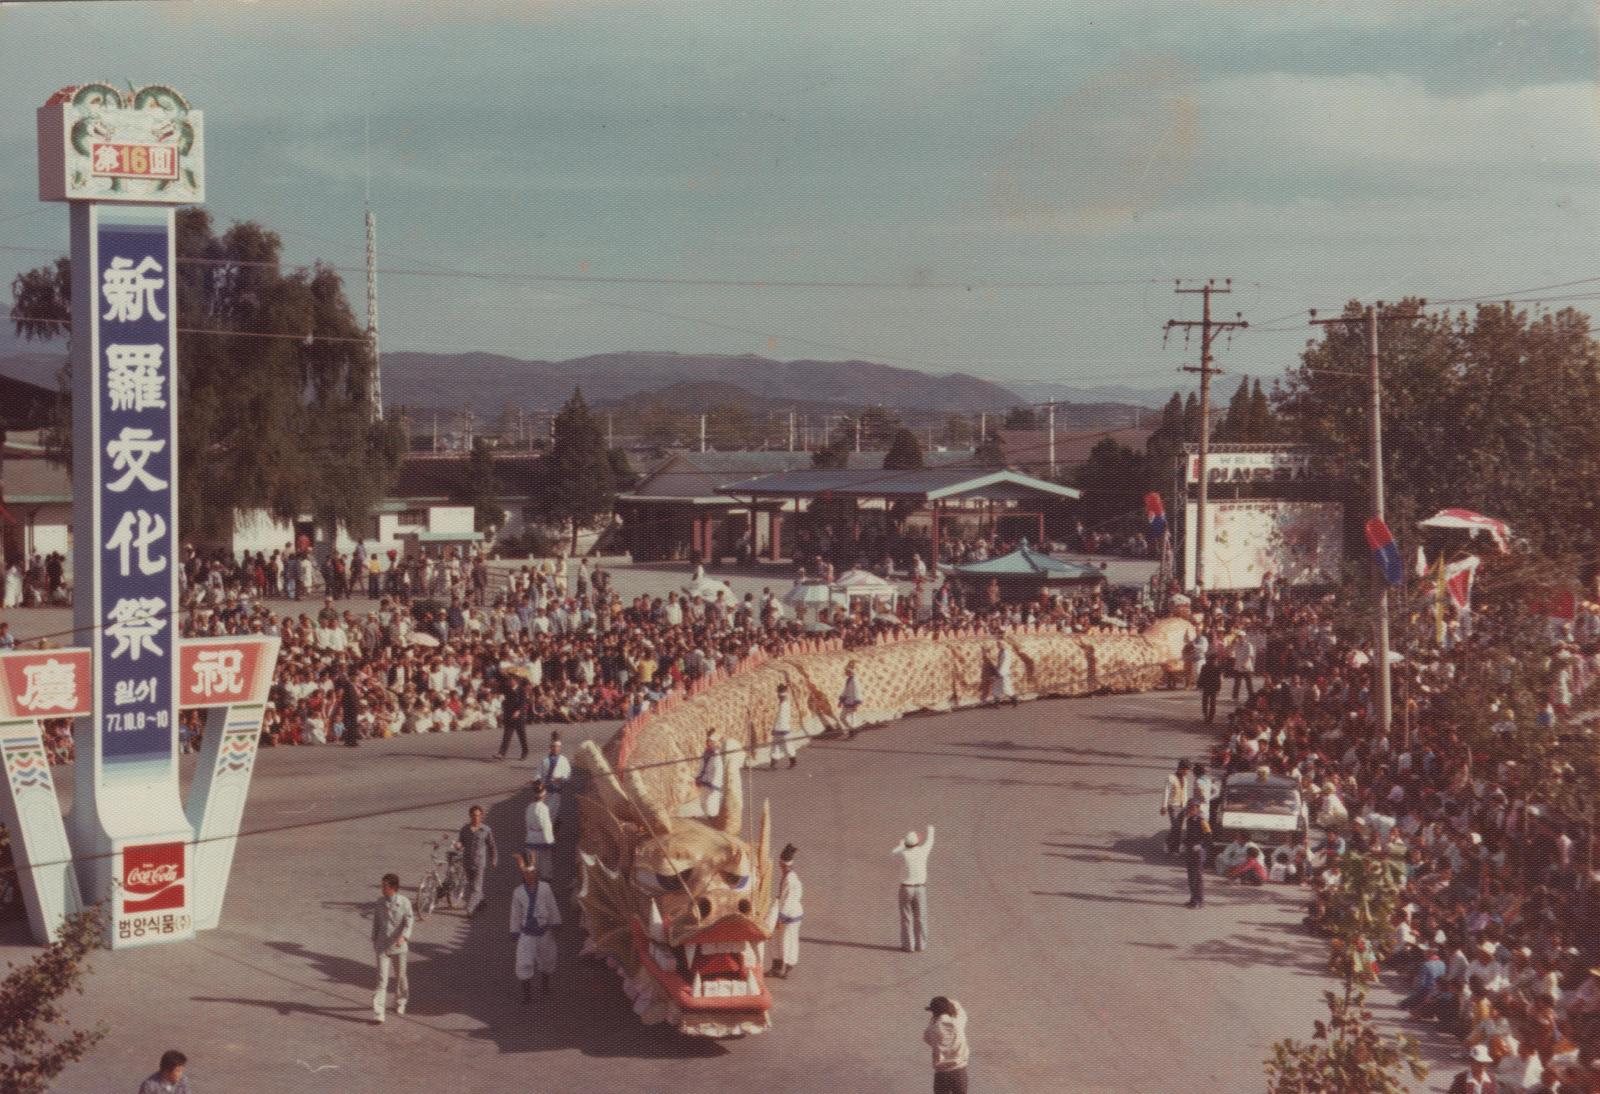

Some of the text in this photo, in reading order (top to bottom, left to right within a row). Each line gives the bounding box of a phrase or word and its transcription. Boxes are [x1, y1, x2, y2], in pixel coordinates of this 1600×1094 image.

[102, 255, 168, 661] 新羅文化祭
[16, 658, 78, 711] 慶
[191, 649, 244, 697] 祝
